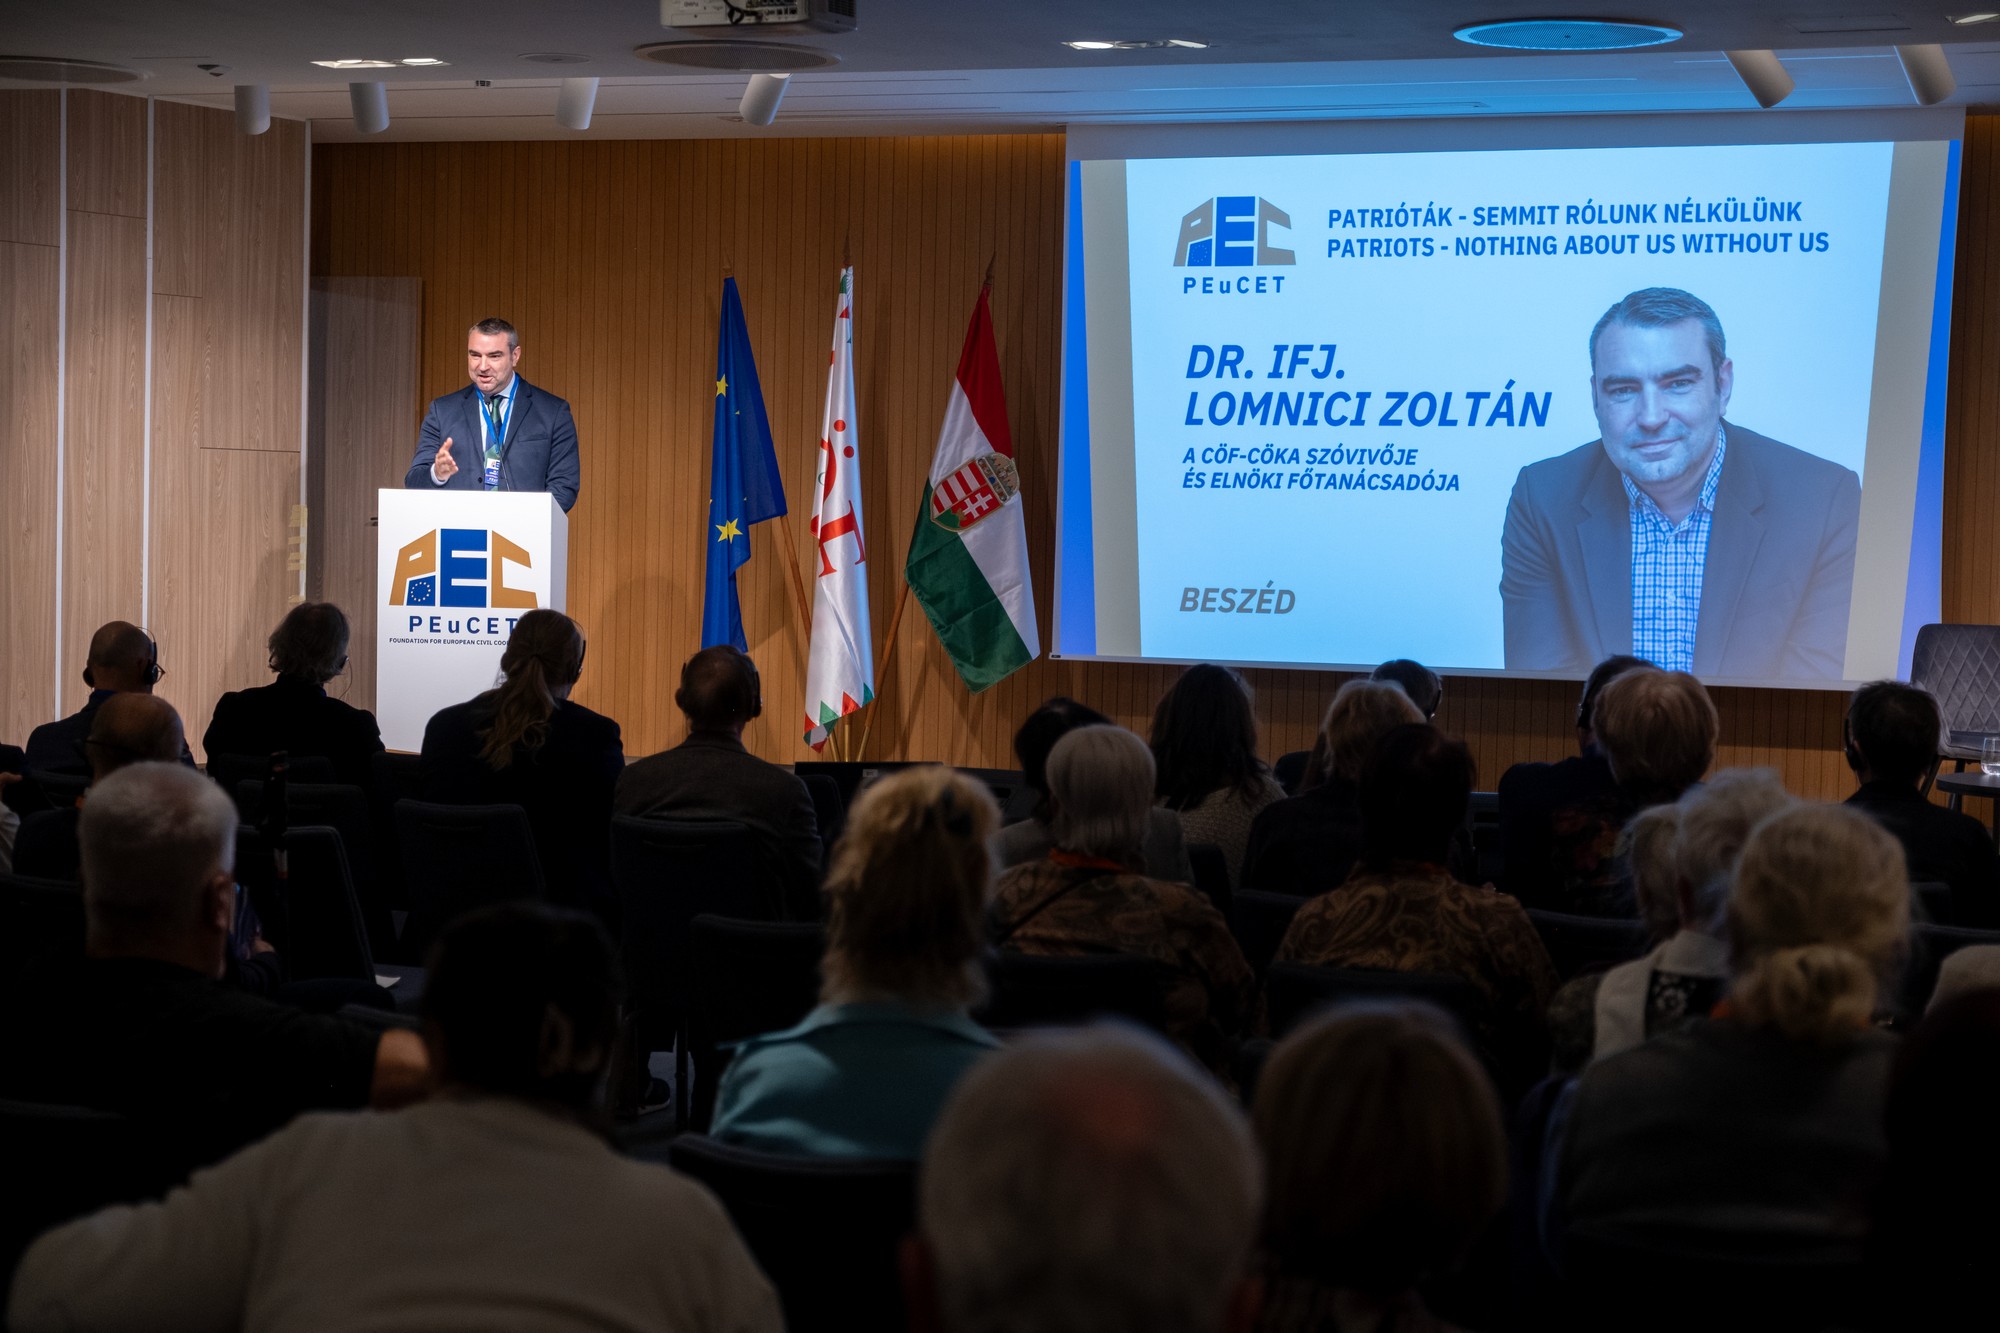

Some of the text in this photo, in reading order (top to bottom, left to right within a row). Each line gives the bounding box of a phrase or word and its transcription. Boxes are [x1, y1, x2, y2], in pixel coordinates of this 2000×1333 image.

[1328, 201, 1453, 229] PATRIÓTÁK
[1473, 205, 1560, 226] SEMMIT
[1566, 198, 1657, 225] RÓLUNK
[1664, 196, 1803, 224] NÉLKÜLÜNK
[1327, 237, 1435, 258] PATRIOTS
[1455, 236, 1558, 256] NOTHING
[1564, 234, 1640, 255] ABOUT
[1646, 234, 1676, 254] US
[1682, 232, 1793, 253] WITHOUT
[1799, 232, 1830, 252] US
[1183, 276, 1286, 294] PEuCET
[1185, 344, 1345, 379] DR. IFJ.
[1185, 379, 1553, 427] LOMNICI ZOLTÁN
[1182, 443, 1419, 466] A CÖF-CÖKA SZÓVIVŐJE
[1182, 467, 1460, 491] ÉS ELNÖKI FŐTANÁCSADÓJA
[1179, 580, 1296, 614] BESZÉD
[409, 615, 518, 635] PEuCET
